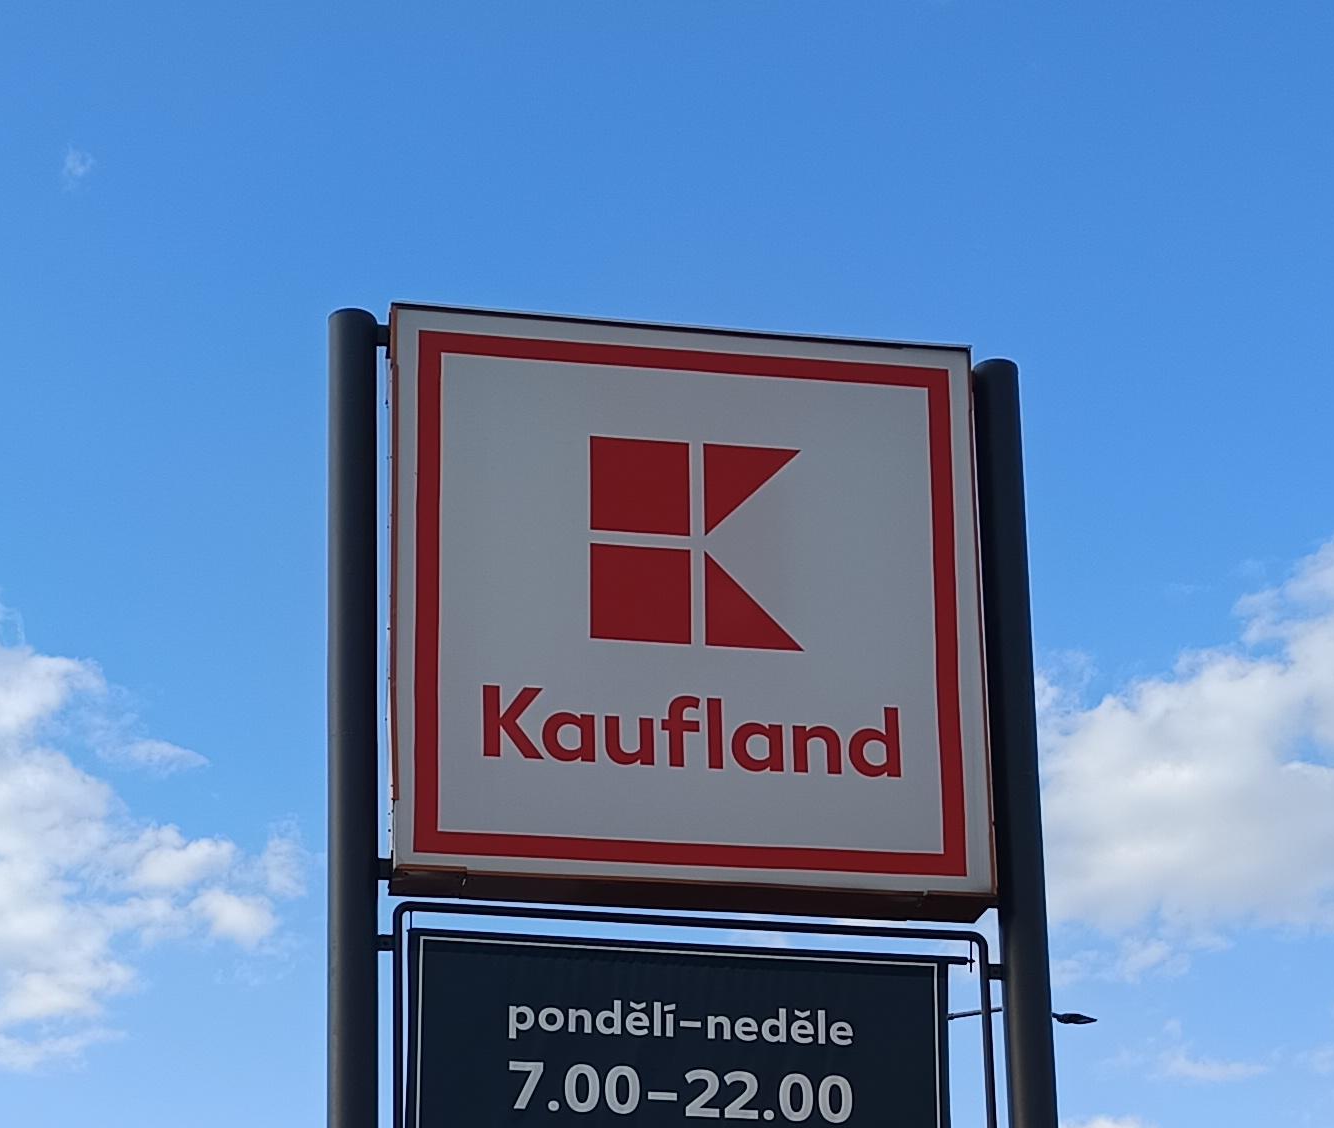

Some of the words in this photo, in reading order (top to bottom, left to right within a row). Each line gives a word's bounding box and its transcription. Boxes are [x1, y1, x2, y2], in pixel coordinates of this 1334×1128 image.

[482, 684, 903, 778] Kaufland
[508, 999, 854, 1047] pondělí–neděle
[508, 1060, 854, 1124] 7.00–22.00
